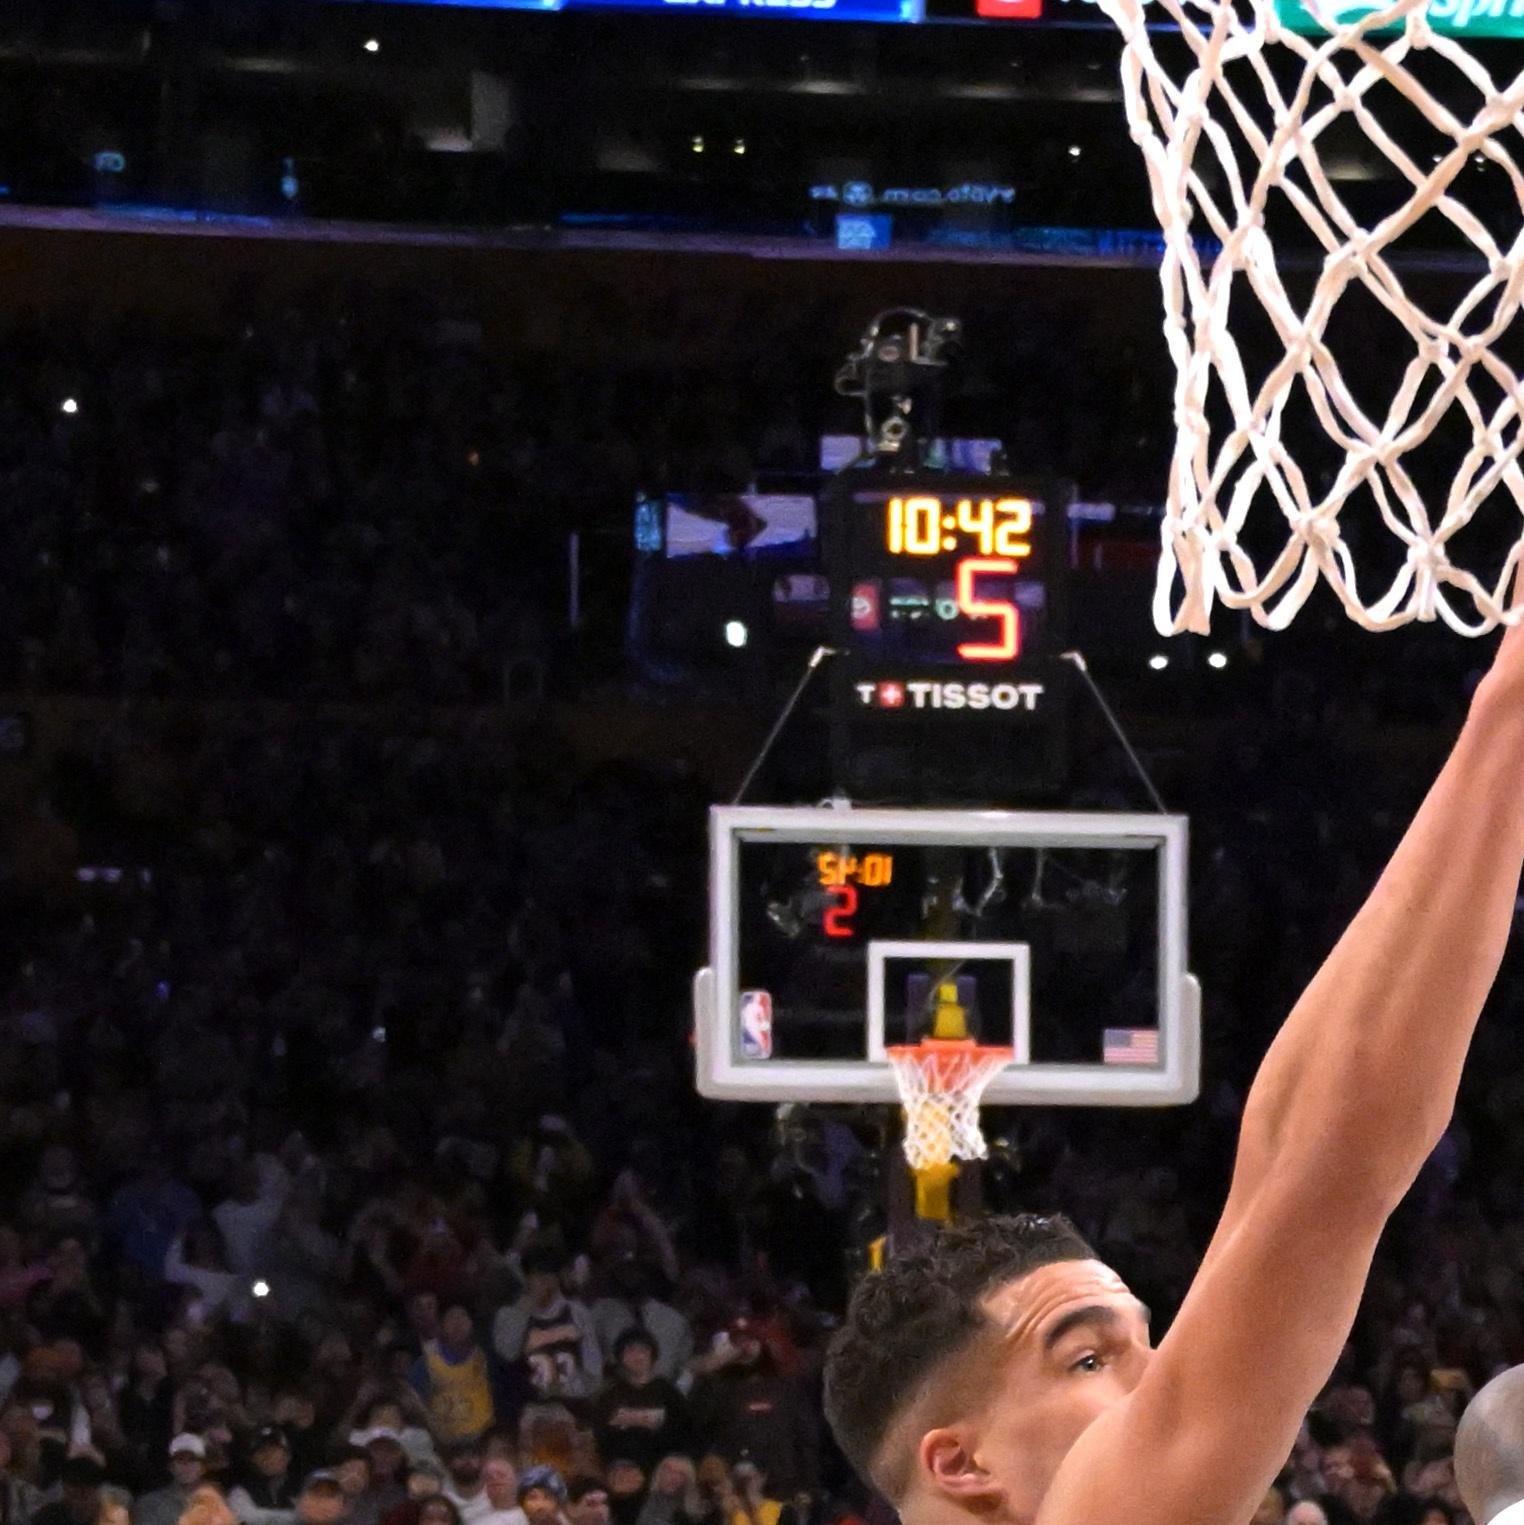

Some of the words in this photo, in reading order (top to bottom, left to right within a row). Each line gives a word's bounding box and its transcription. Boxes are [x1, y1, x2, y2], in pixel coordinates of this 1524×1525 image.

[886, 497, 1032, 557] 10:42
[955, 556, 1021, 661] 5
[907, 683, 1044, 711] TISSOT
